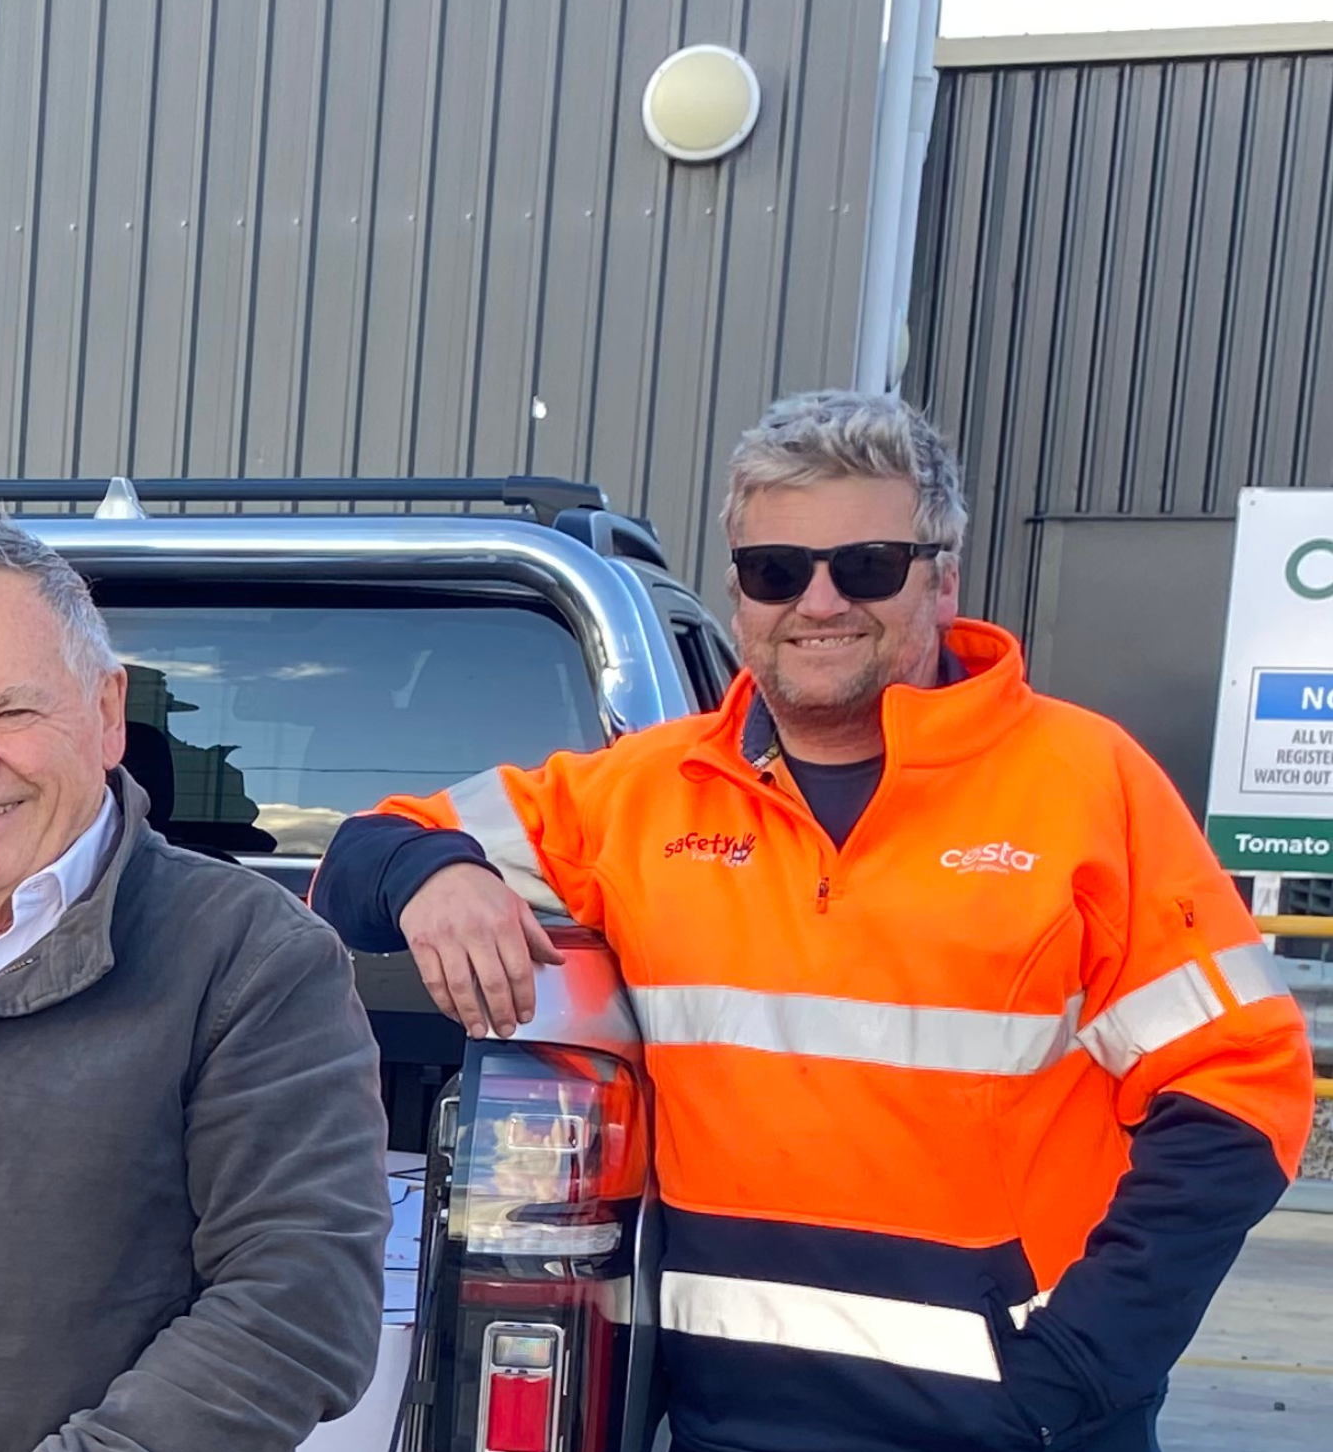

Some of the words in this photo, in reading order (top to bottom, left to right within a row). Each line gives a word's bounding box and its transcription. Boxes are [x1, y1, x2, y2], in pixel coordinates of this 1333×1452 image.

[1292, 729, 1317, 745] ALL
[1276, 749, 1333, 765] REGISTE
[1254, 769, 1300, 785] WATCH
[1303, 769, 1332, 785] OUT
[1235, 833, 1330, 855] Tomato
[940, 841, 1035, 871] costa
